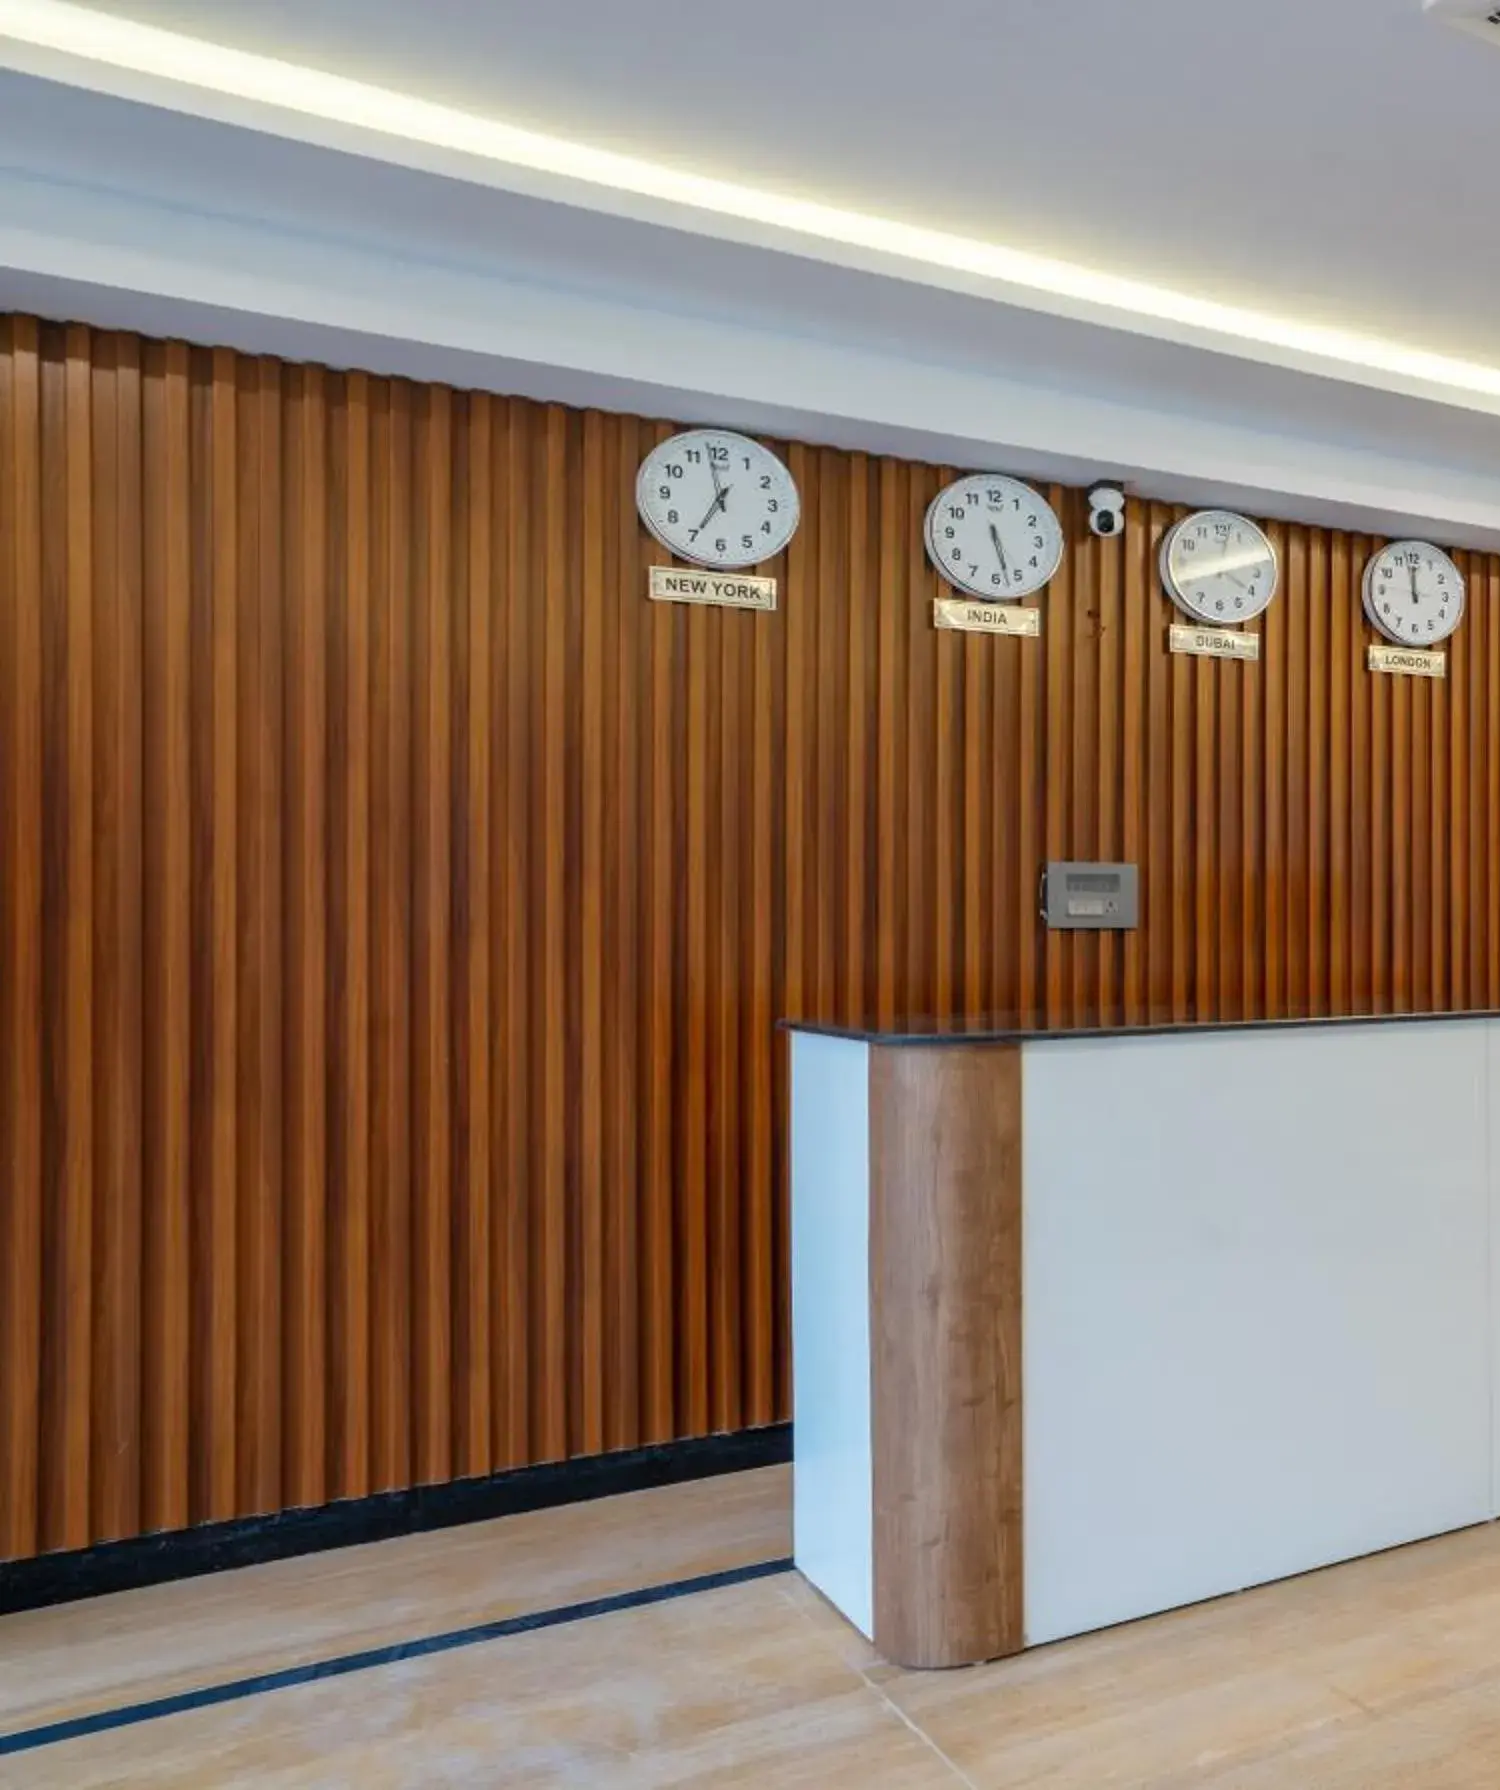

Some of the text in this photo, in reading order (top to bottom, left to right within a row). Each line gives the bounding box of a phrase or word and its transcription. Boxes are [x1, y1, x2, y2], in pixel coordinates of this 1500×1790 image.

[686, 450, 700, 463] 11
[711, 447, 728, 461] 12
[743, 458, 750, 470] 1
[665, 464, 683, 478] 10
[760, 476, 771, 489] 2
[660, 486, 670, 499] 9
[966, 493, 979, 505] 11
[987, 490, 1002, 502] 12
[768, 499, 778, 513] 3
[1013, 499, 1020, 510] 1
[667, 510, 679, 523] 8
[949, 508, 964, 520] 10
[761, 521, 771, 534] 4
[1028, 515, 1037, 527] 2
[688, 529, 699, 542] 7
[945, 527, 954, 538] 9
[716, 539, 726, 552] 6
[742, 535, 752, 549] 5
[1034, 536, 1043, 549] 3
[952, 548, 961, 560] 8
[1029, 556, 1037, 568] 4
[968, 565, 978, 577] 7
[1014, 570, 1022, 581] 5
[992, 574, 1000, 585] 6
[666, 578, 761, 599] NEW YORK
[967, 610, 1007, 624] INDIA
[1196, 635, 1235, 650] DUBAI
[1386, 655, 1430, 669] LONDON
